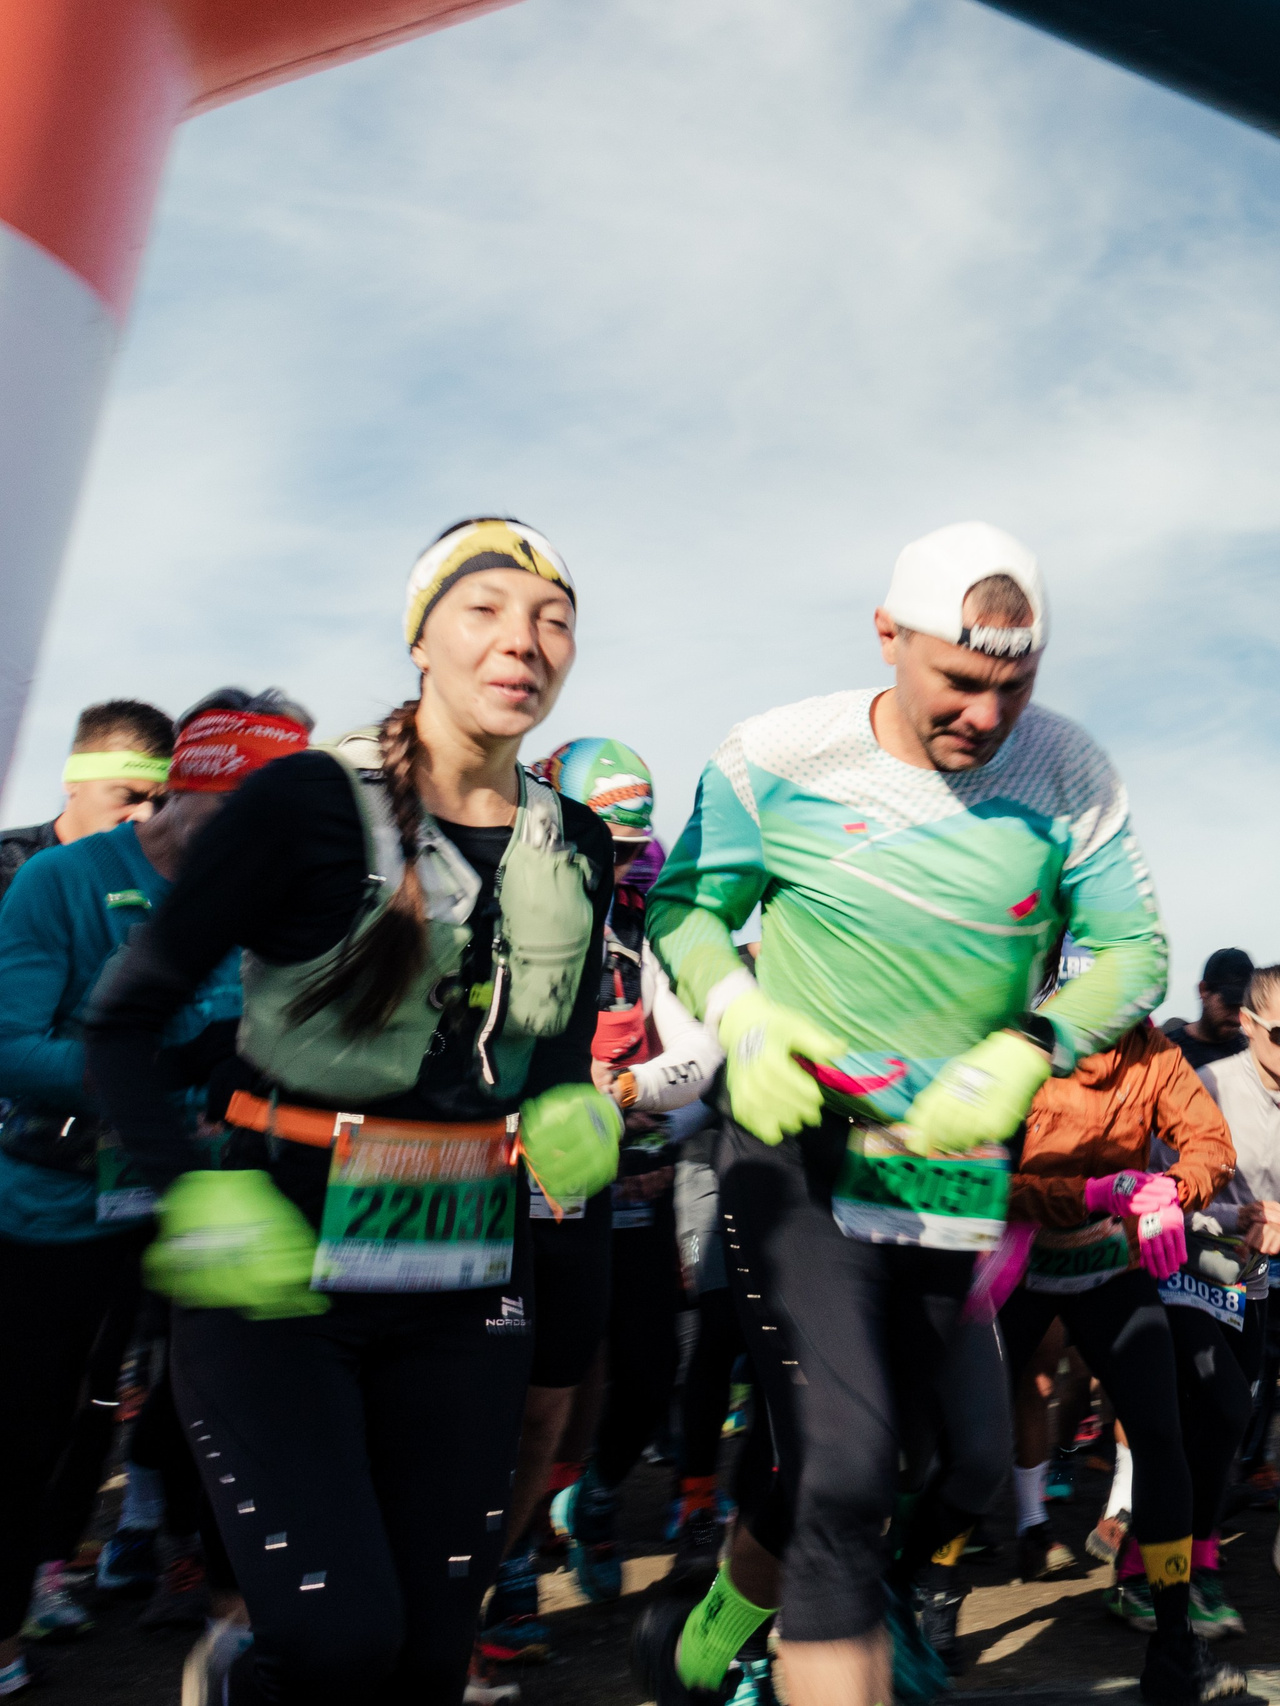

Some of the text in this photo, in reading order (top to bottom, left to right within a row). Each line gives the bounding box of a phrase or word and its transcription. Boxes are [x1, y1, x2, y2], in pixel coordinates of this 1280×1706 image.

[344, 1184, 510, 1241] 22032
[1166, 1272, 1240, 1313] 30038
[485, 1318, 532, 1327] NORDS
